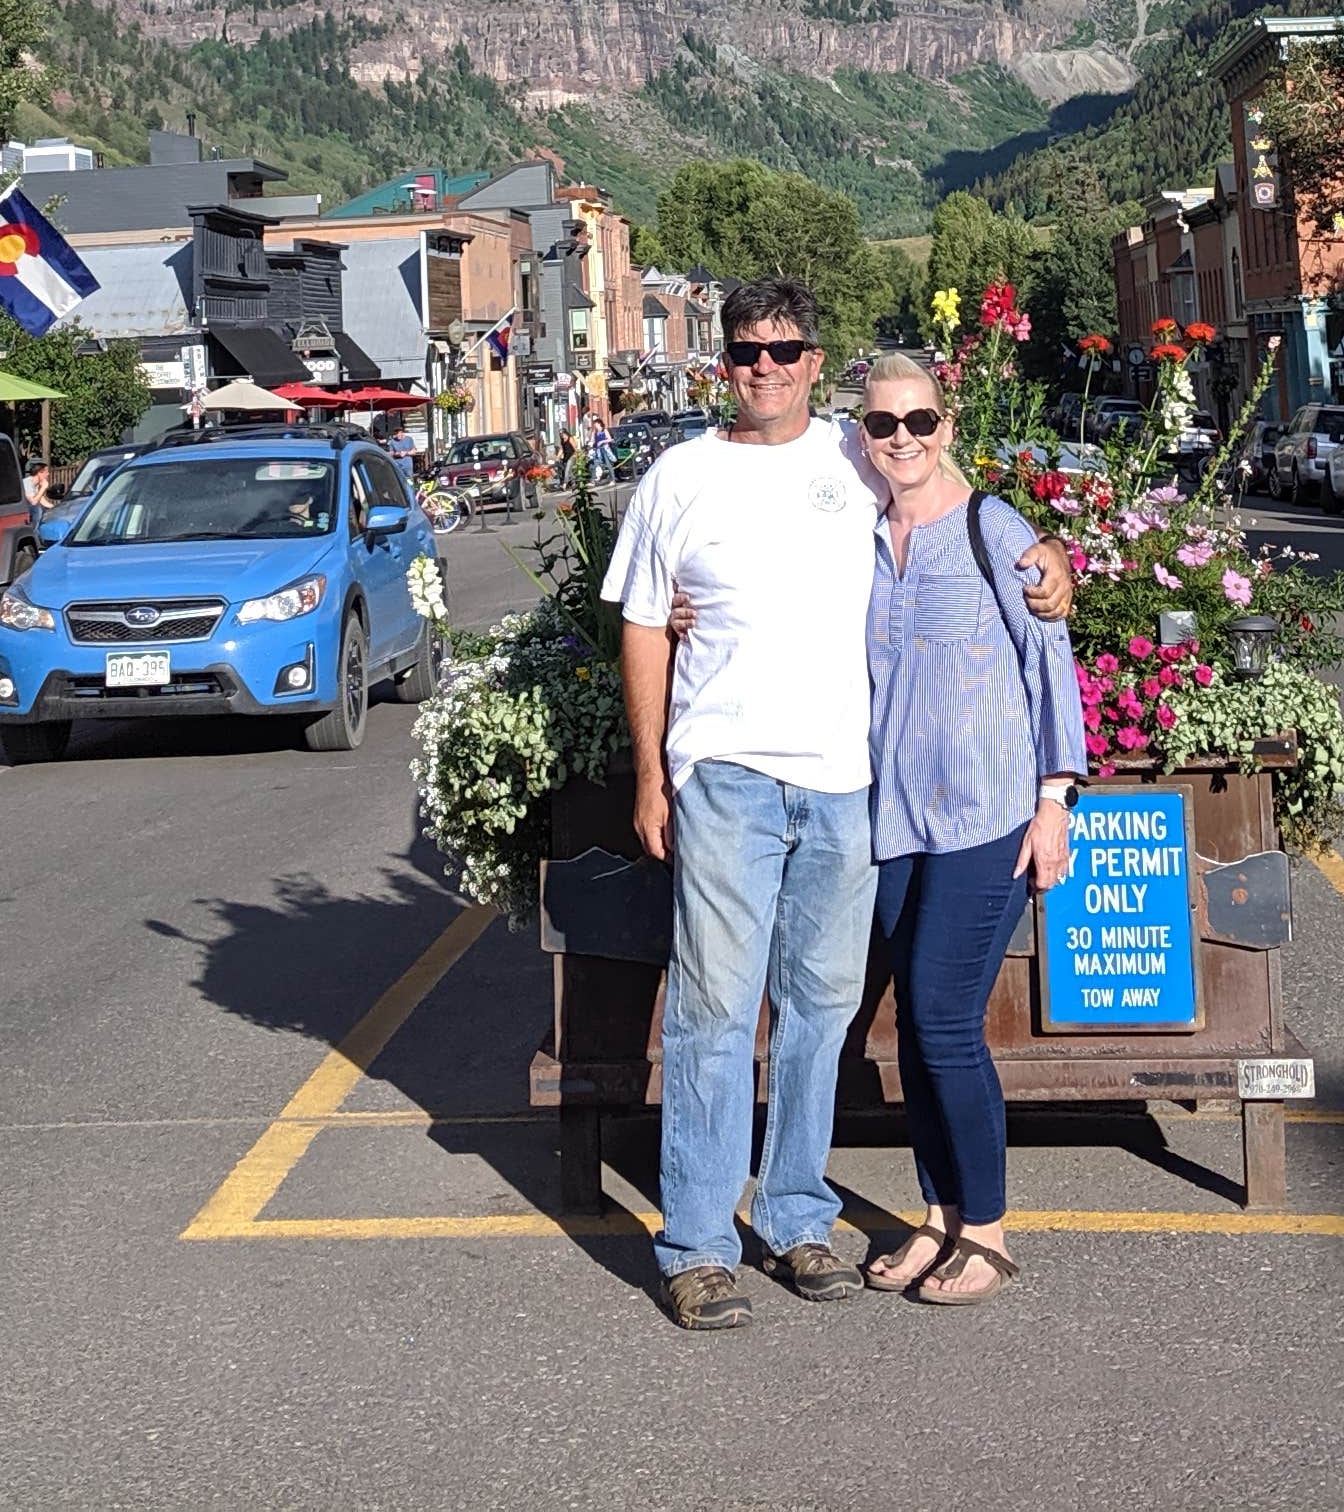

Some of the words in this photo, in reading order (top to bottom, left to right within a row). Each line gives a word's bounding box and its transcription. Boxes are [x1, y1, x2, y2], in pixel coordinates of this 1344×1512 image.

[1067, 810, 1167, 841] PARKING
[1068, 848, 1079, 878] Y
[1090, 847, 1183, 877] PERMIT
[1084, 883, 1148, 914] ONLY
[1066, 926, 1092, 949] 30
[1101, 925, 1172, 948] MINUTE
[1074, 952, 1166, 976] MAXIMUM
[1080, 988, 1114, 1008] TOW
[1121, 988, 1161, 1007] AWAY
[1243, 1064, 1309, 1088] STRONGHOLD
